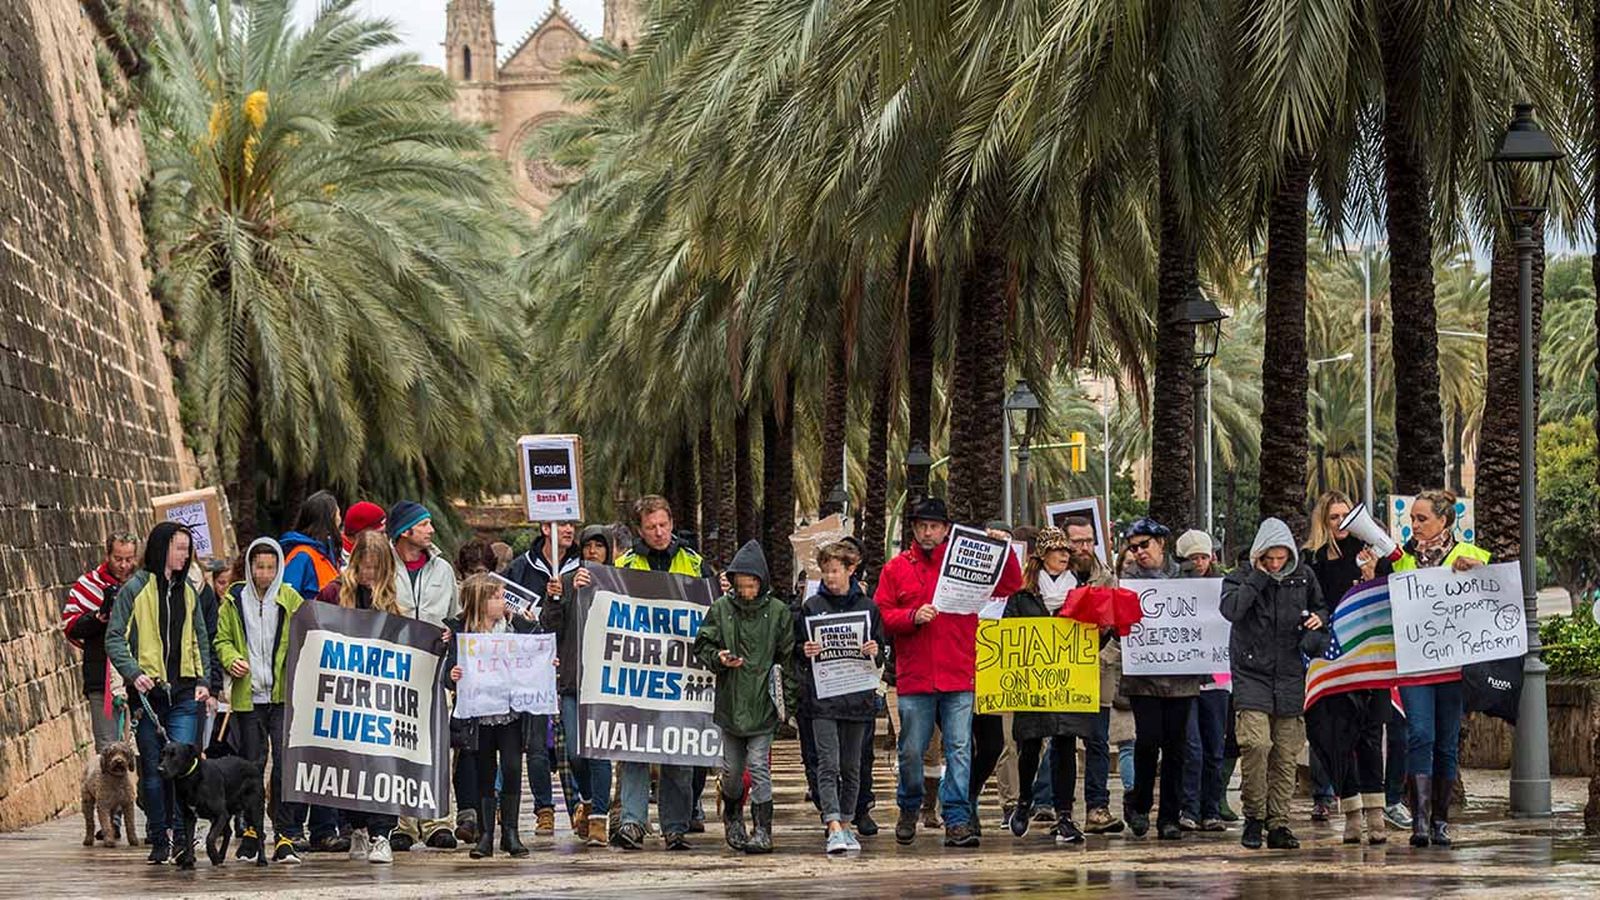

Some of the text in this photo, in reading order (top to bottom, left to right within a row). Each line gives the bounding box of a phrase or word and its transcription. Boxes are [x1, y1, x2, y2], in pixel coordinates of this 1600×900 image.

[534, 465, 566, 475] ENOUGH
[537, 494, 556, 502] Basta
[958, 547, 994, 562] FOR OUR
[960, 539, 991, 553] MARCH
[956, 556, 979, 568] LIVES
[949, 566, 992, 583] MALLORCA
[1396, 574, 1437, 600] The
[1140, 588, 1197, 619] GUN
[607, 600, 705, 638] MARCH
[820, 625, 852, 635] MARCH
[821, 632, 858, 642] FOR OUR
[823, 640, 846, 648] LIVES
[976, 619, 1099, 672] SHAME
[1127, 622, 1202, 647] REFORM
[320, 639, 412, 682] MARCH
[604, 632, 661, 665] FOR
[1130, 651, 1176, 666] SHOULD
[1422, 641, 1454, 660] Gun
[601, 666, 683, 701] LIVES
[1000, 668, 1070, 692] ON YOU
[317, 674, 372, 709] FOR
[375, 682, 419, 719] OUR
[313, 708, 392, 746] LIVES
[585, 719, 724, 757] MALLORC
[295, 762, 437, 809] MALLORCA
